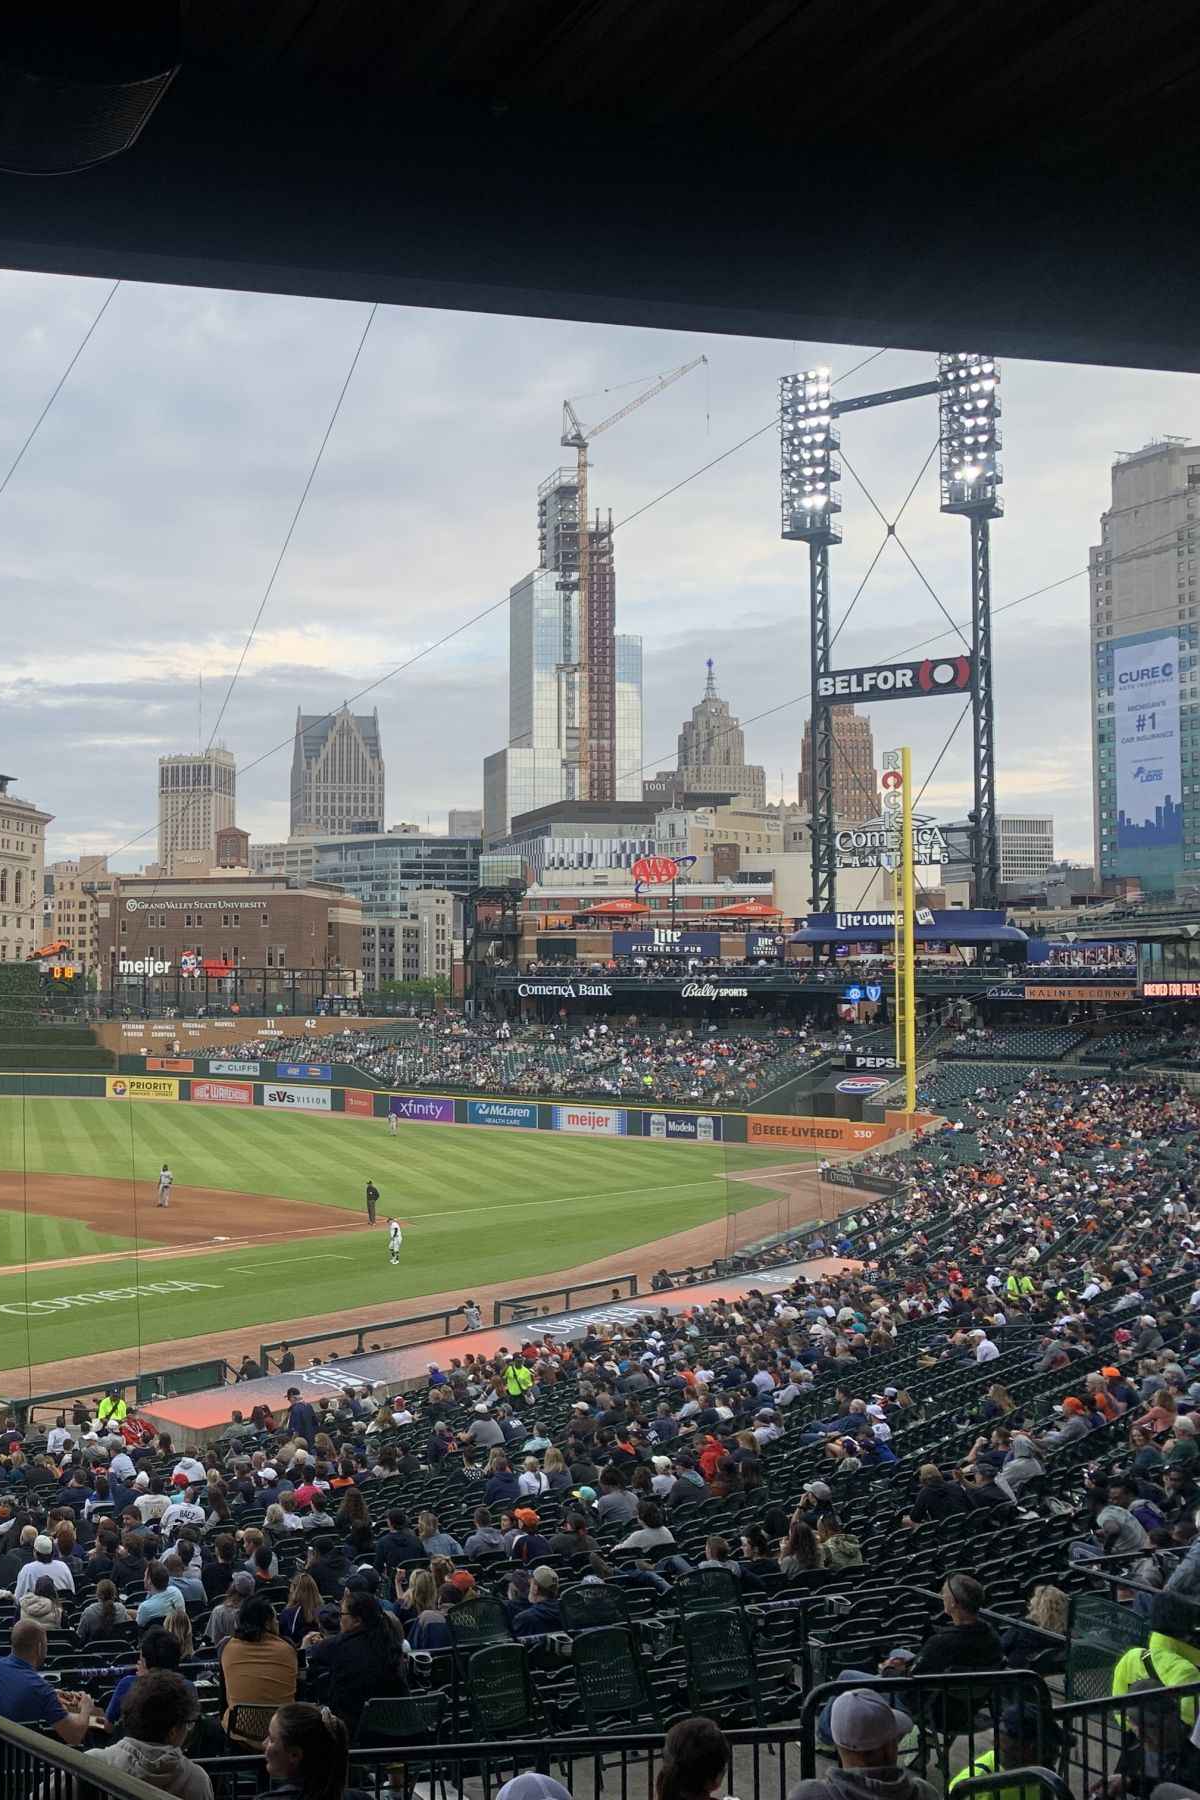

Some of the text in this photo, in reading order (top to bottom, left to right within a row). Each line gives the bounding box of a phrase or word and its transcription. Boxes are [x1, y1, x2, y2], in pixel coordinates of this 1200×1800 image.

[818, 668, 913, 696] BELFOR
[1119, 667, 1161, 684] CURE
[1128, 700, 1167, 712] MICHIGAN'S
[1136, 712, 1156, 732] #1
[1136, 731, 1175, 742] INSURANCE
[644, 783, 667, 791] 1001
[634, 857, 678, 877] AAA
[137, 900, 267, 910] GRAND VALLEY STATE UNIVERSITY
[836, 913, 861, 930] Lite
[653, 928, 682, 946] Lite
[758, 937, 773, 946] Lite
[53, 966, 74, 978] 0:18
[119, 957, 172, 977] meijer
[579, 983, 612, 996] Bank
[682, 983, 748, 1001] Bally SPORTS
[1143, 983, 1168, 996] BREWED
[1169, 984, 1181, 996] FOR
[266, 1020, 275, 1029] 11
[304, 1019, 317, 1029] 42
[228, 1064, 258, 1073] CLIFFS
[130, 1081, 173, 1091] PRIORITY
[194, 1084, 249, 1101] ABC WAREHOUSE
[297, 1096, 327, 1105] VISION
[400, 1100, 443, 1119] xfinity
[490, 1104, 530, 1118] McLaren
[567, 1111, 610, 1130] meijer
[668, 1120, 696, 1133] Modelo
